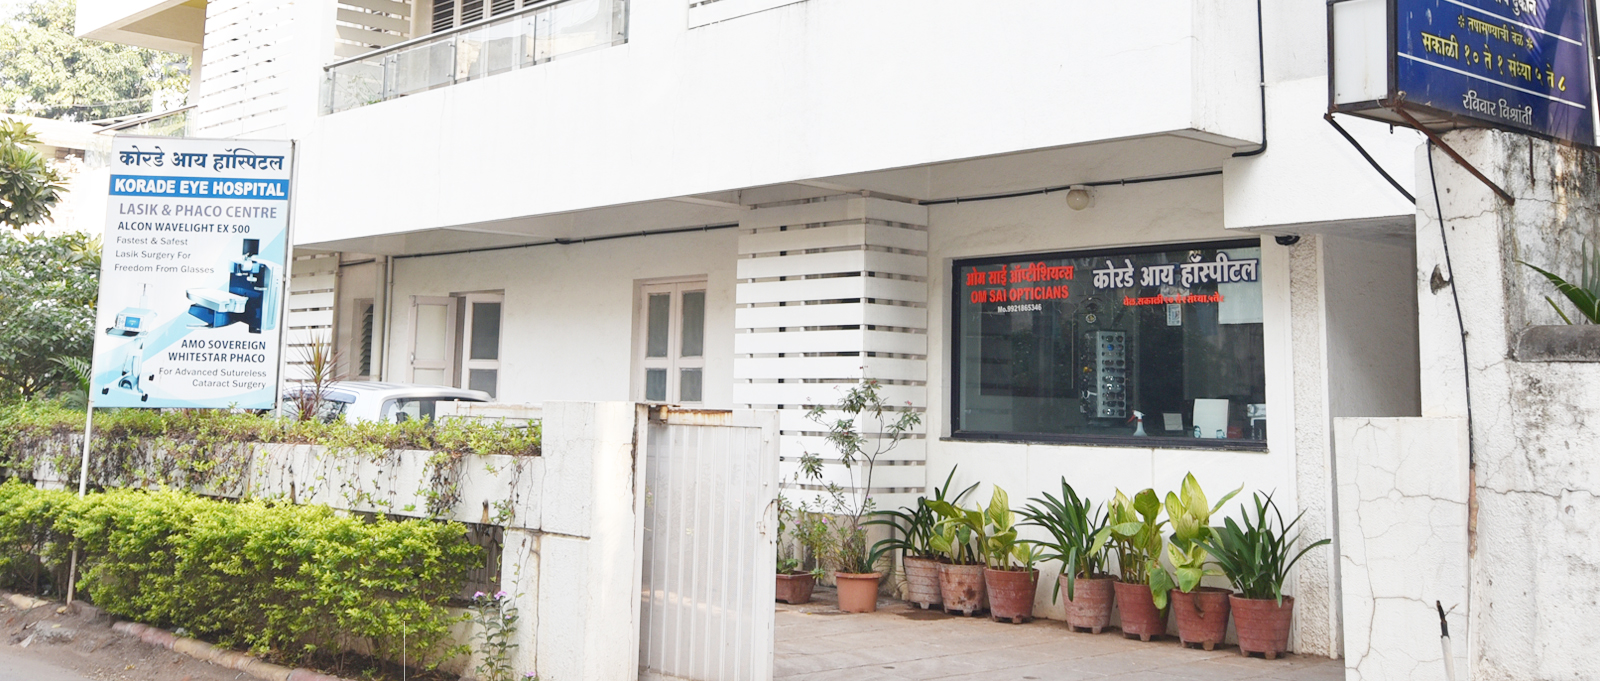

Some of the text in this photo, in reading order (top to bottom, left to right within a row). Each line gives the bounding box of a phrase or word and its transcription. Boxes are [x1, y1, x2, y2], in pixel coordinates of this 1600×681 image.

[1421, 32, 1459, 59] सकाळी
[1465, 45, 1479, 65] १०
[1484, 44, 1492, 70] ते
[1508, 54, 1532, 81] संध्या
[1546, 64, 1555, 88] ते
[1463, 90, 1532, 125] रविवार विश्रांती
[119, 145, 284, 172] कोरडे आय हॉस्पिटल
[115, 178, 285, 196] KORADE EYE HOSPITAL
[119, 203, 277, 219] LASIK & PHACO CENTRE
[118, 222, 250, 233] ALCON WAVELIGHT EX 500
[116, 236, 188, 246] Fastest & Safest
[115, 250, 139, 258] Lasik
[141, 251, 175, 260] Surgery
[114, 264, 214, 274] Freedom From Glasses
[966, 262, 1074, 286] ओम साई ऑप्टीशियन्स
[1093, 252, 1258, 289] कोरडे आय हॉस्पीटल
[971, 285, 1069, 303] OM SAI OPTICIANS
[181, 339, 266, 350] AMO SOVEREIGN
[168, 352, 266, 363] WHITESTAR PHACO
[159, 367, 267, 377] For Advanced Sutureless
[192, 379, 267, 389] Cataract Surgery
